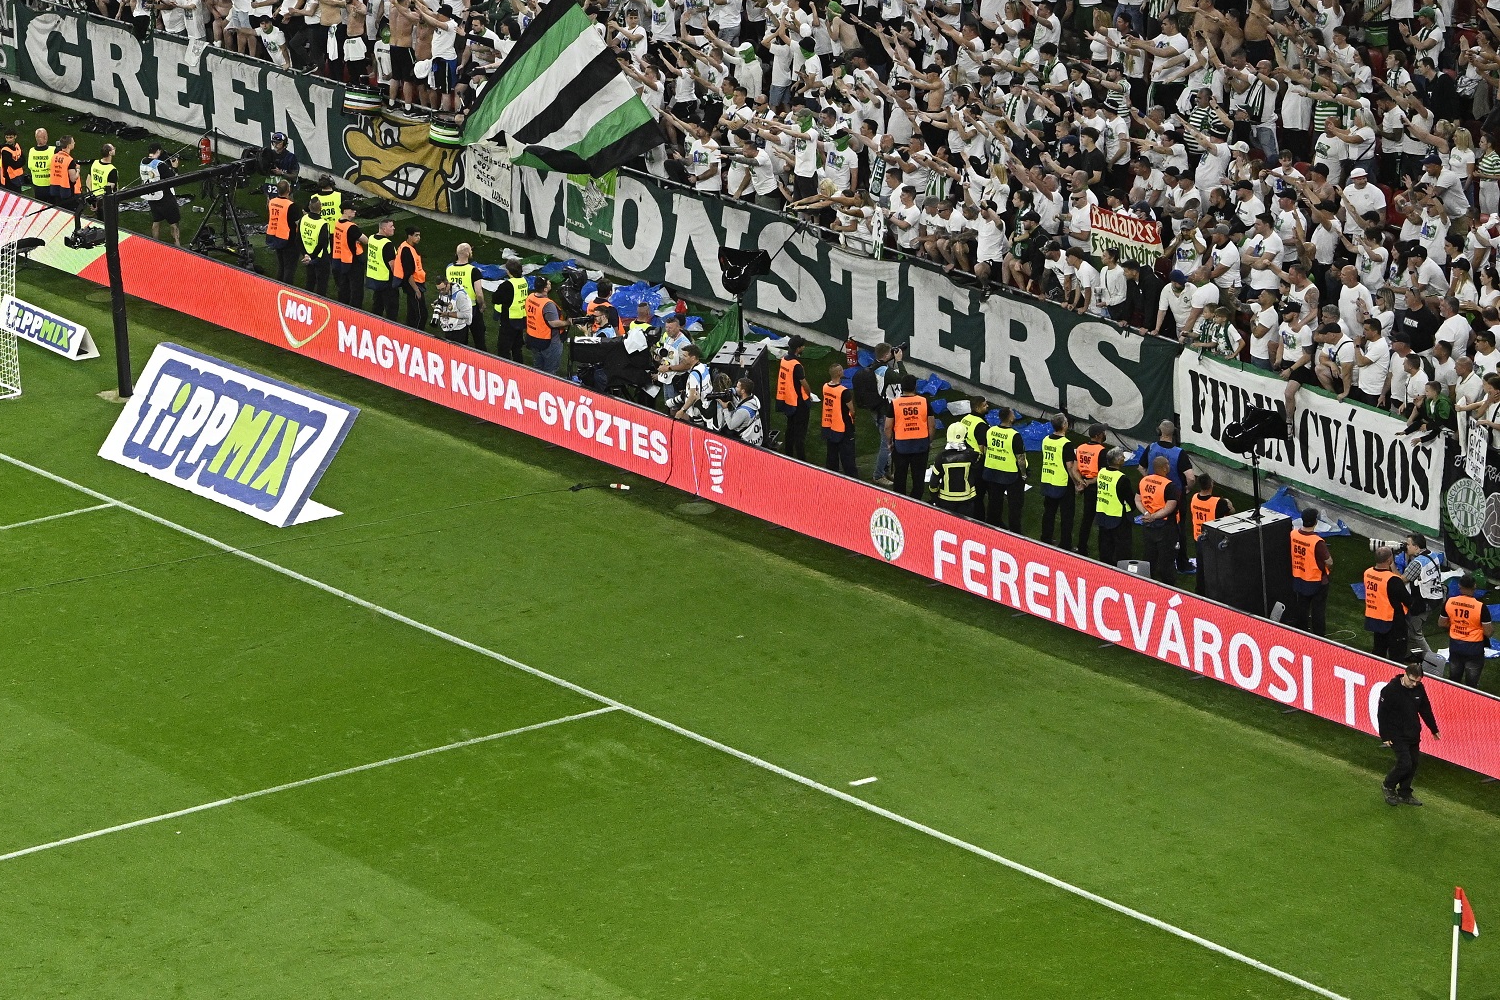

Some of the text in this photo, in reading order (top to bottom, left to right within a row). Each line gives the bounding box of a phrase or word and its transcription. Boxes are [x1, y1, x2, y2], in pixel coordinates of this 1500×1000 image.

[34, 161, 46, 169] 427
[267, 185, 278, 194] 32
[25, 13, 1145, 431] GREEN MONSTERS
[7, 304, 71, 350] TiPPMIX
[284, 299, 669, 465] MOL MAGYAR KUPA-GYŐZTES
[902, 407, 919, 416] 656
[132, 374, 316, 497] TiPPMIX
[991, 438, 1005, 449] 361
[1366, 580, 1378, 592] 250
[1454, 608, 1470, 620] 178
[932, 529, 1315, 712] FERENCVÁROSI
